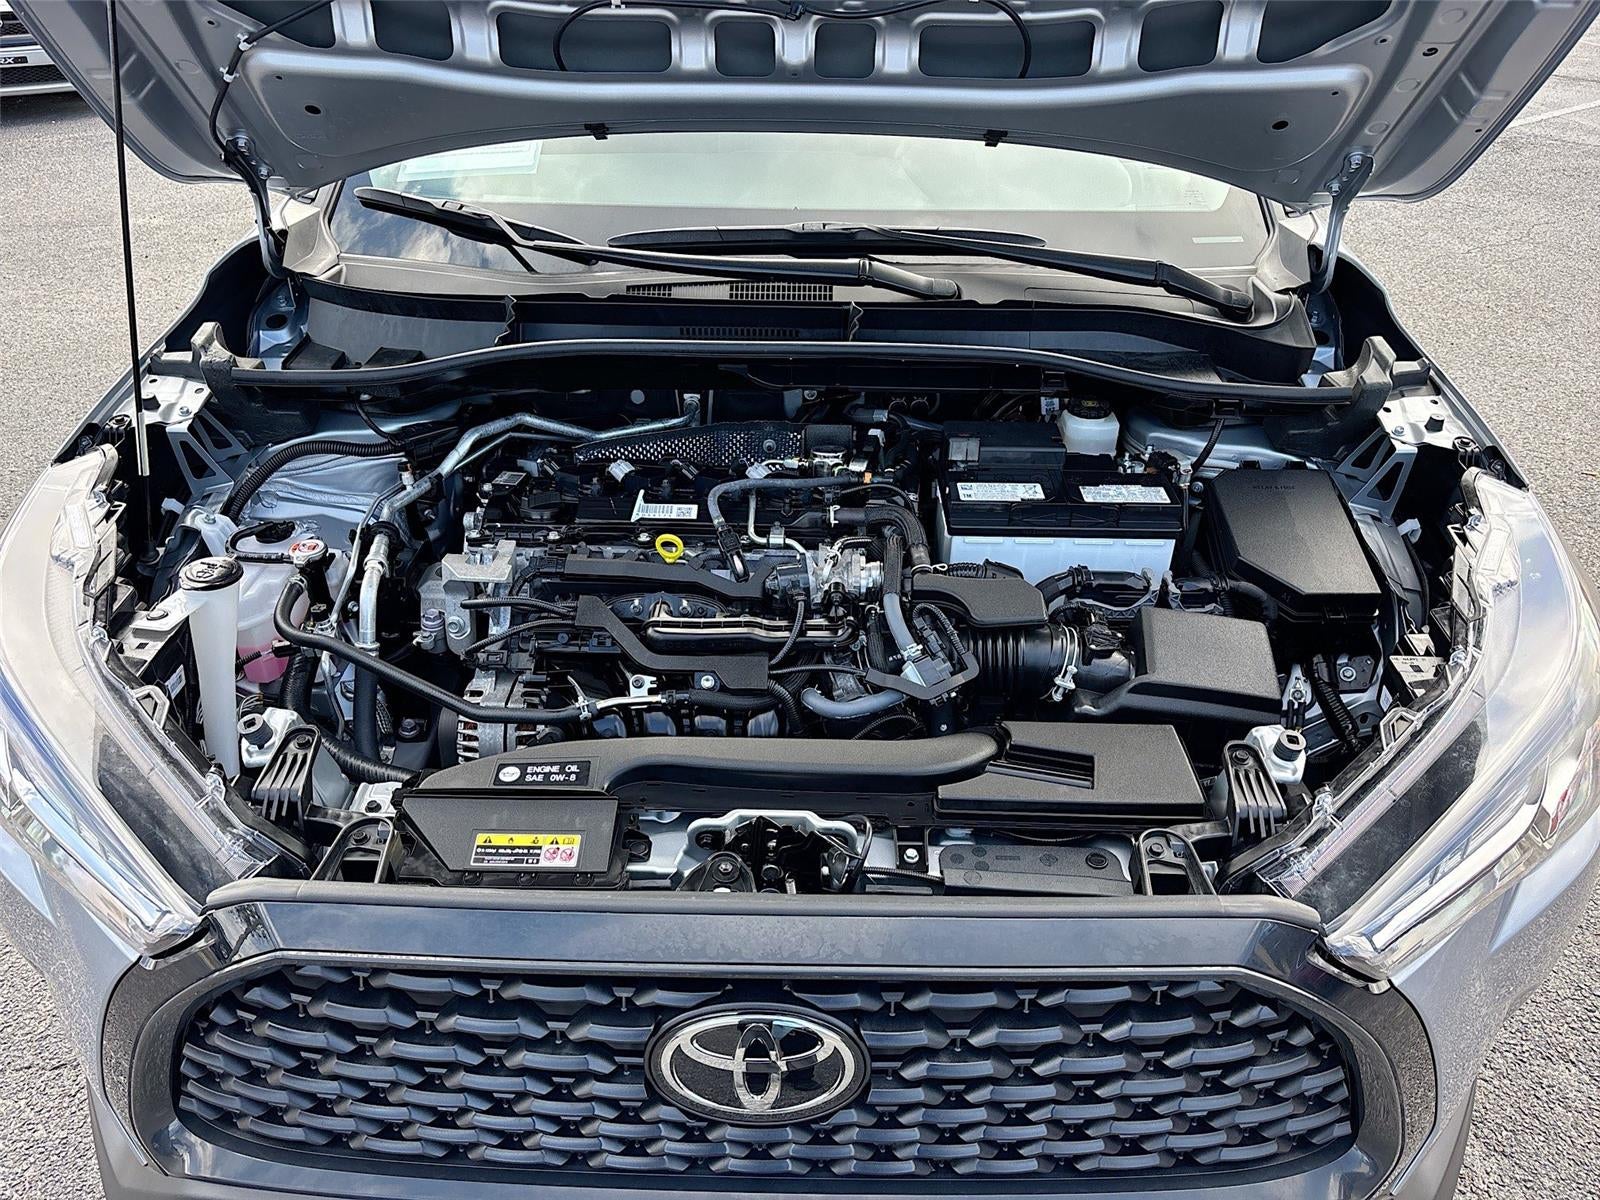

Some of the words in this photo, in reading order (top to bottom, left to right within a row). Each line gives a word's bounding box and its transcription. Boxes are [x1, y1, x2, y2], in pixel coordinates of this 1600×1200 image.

[526, 765, 560, 773] ENGINE
[565, 764, 580, 772] OIL
[525, 774, 544, 782] SAE
[549, 774, 576, 782] 0W-8
